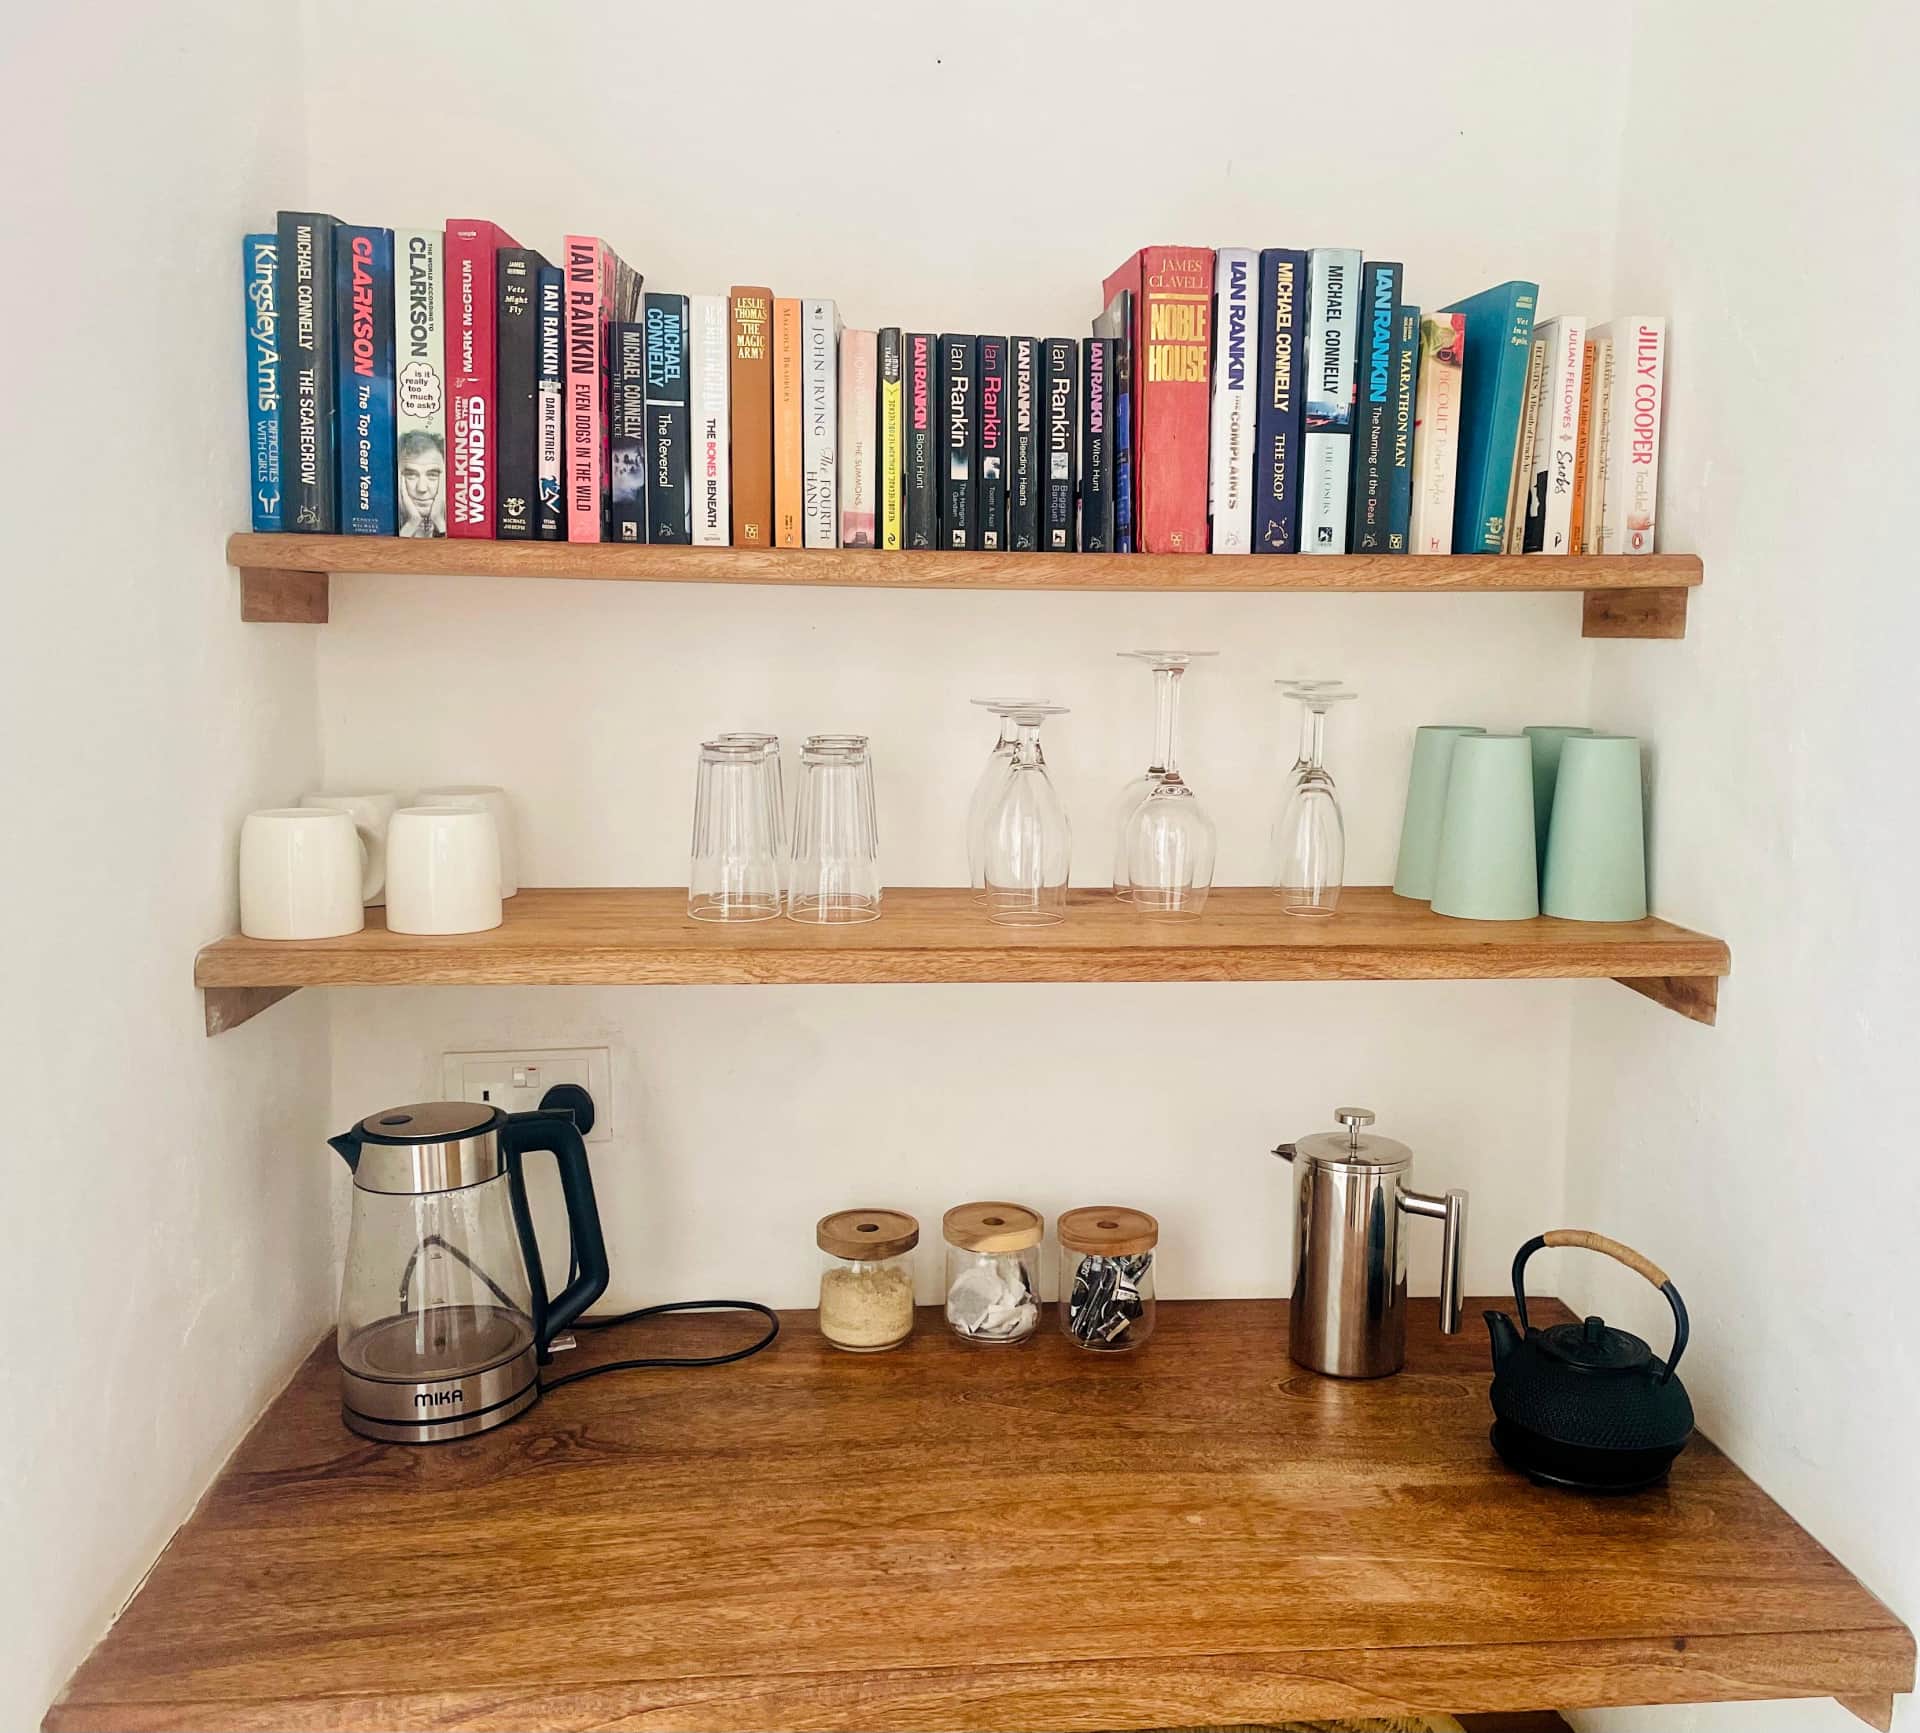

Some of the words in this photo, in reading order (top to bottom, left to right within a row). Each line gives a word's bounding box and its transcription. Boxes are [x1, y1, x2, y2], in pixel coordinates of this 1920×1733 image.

[297, 226, 313, 280] MICHAEL
[571, 244, 594, 283] IAN
[1161, 259, 1203, 273] JAMES
[249, 244, 276, 351] Kingsley
[409, 237, 428, 357] CLARKSON
[462, 259, 473, 326] McCRUM
[507, 285, 526, 293] Vets
[543, 284, 560, 312] IAN
[1149, 275, 1208, 289] CLAVELL
[1230, 261, 1247, 300] IAN
[1276, 262, 1293, 332] MICHAEL
[1326, 265, 1344, 323] MICHAEL
[1374, 269, 1393, 310] IAN
[298, 286, 313, 351] CONNELLY
[351, 236, 376, 377] CLARKSON
[504, 295, 529, 305] Might
[509, 305, 523, 316] Fly
[734, 308, 768, 320] THOMAS
[737, 297, 766, 309] LESLIE
[428, 323, 434, 331] TO
[571, 291, 594, 375] RANKIN
[742, 323, 760, 335] THE
[1150, 303, 1206, 342] NOBLE
[1517, 317, 1528, 325] Vet
[463, 329, 473, 373] MARK
[543, 317, 560, 375] RANKIN
[623, 331, 641, 380] MICHAEL
[647, 308, 664, 388] CONNELLY
[663, 314, 681, 384] MICHAEL
[737, 334, 765, 347] MAGIC
[738, 346, 765, 359] ARMY
[812, 328, 825, 371] JOHN
[914, 338, 927, 367] IAN
[951, 344, 967, 371] Ian
[984, 344, 1000, 371] Ian
[1017, 341, 1031, 368] IAN
[1053, 344, 1069, 372] Ian
[1091, 343, 1103, 372] IAN
[1228, 305, 1246, 391] RANKIN
[1370, 310, 1391, 403] RANKIN
[1567, 328, 1577, 368] JULIAN
[1636, 326, 1658, 380] JILLY
[1149, 345, 1208, 383] HOUSE
[1273, 333, 1292, 413] CONNELLY
[1323, 330, 1341, 394] CONNELLY
[257, 351, 278, 411] Amis
[299, 368, 314, 395] THE
[358, 385, 371, 409] The
[405, 379, 428, 387] really
[575, 384, 591, 411] EVEN
[613, 373, 622, 390] THE
[914, 367, 928, 430] RANKIN
[1397, 350, 1412, 433] MARATHON
[461, 398, 469, 417] THE
[545, 398, 556, 422] DARK
[613, 393, 622, 421] BLACK
[623, 384, 641, 440] CONNELLY
[813, 378, 826, 437] IRVING
[951, 377, 969, 448] Rankin
[984, 377, 1002, 449] Rankin
[1017, 369, 1031, 432] RANKIN
[1052, 378, 1070, 450] Rankin
[1091, 372, 1103, 433] RANKIN
[1371, 406, 1382, 424] The
[1437, 370, 1449, 434] PICOULT
[1562, 372, 1574, 429] FELLOWES
[257, 421, 267, 450] WITH
[299, 398, 315, 486] SCARECROW
[358, 411, 371, 437] Top
[575, 415, 591, 444] DOGS
[614, 423, 623, 439] ICE
[658, 414, 673, 435] The
[707, 418, 716, 439] THE
[1631, 384, 1656, 465] COOPER
[268, 421, 279, 482] DIFFICULTIES
[360, 439, 371, 469] Gear
[468, 396, 485, 524] WOUNDED
[545, 424, 556, 462] ENTRIES
[575, 447, 591, 458] IN
[706, 441, 717, 477] BONES
[820, 447, 834, 473] The
[855, 441, 863, 458] THE
[916, 433, 925, 463] Blood
[1018, 436, 1028, 475] Bleeding
[1092, 438, 1101, 467] Witch
[1228, 411, 1241, 510] COMPLAINTS
[1274, 433, 1285, 462] THE
[1368, 426, 1382, 464] Naming
[1395, 434, 1407, 468] MAN
[258, 452, 268, 482] GIRLS
[455, 420, 469, 523] WALKING
[576, 462, 591, 481] THE
[658, 438, 674, 488] Reversal
[916, 465, 925, 489] Hunt
[1092, 470, 1101, 492] Hunt
[1273, 462, 1285, 501] DROP
[1369, 466, 1379, 478] of
[1555, 450, 1573, 495] Snobs
[360, 471, 371, 511] Years
[576, 485, 591, 512] WILD
[806, 471, 818, 517] HAND
[854, 460, 863, 506] SUMMONS
[1019, 478, 1028, 506] Hearts
[1368, 479, 1379, 496] the
[1634, 470, 1649, 513] Tackle!
[707, 480, 717, 528] BENEATH
[820, 479, 832, 540] FOURTH
[958, 498, 966, 527] Hanging
[1051, 485, 1060, 522] Banquet
[1059, 485, 1068, 522] Beggars
[1367, 499, 1377, 525] Dead
[414, 1389, 463, 1407] MIKA
